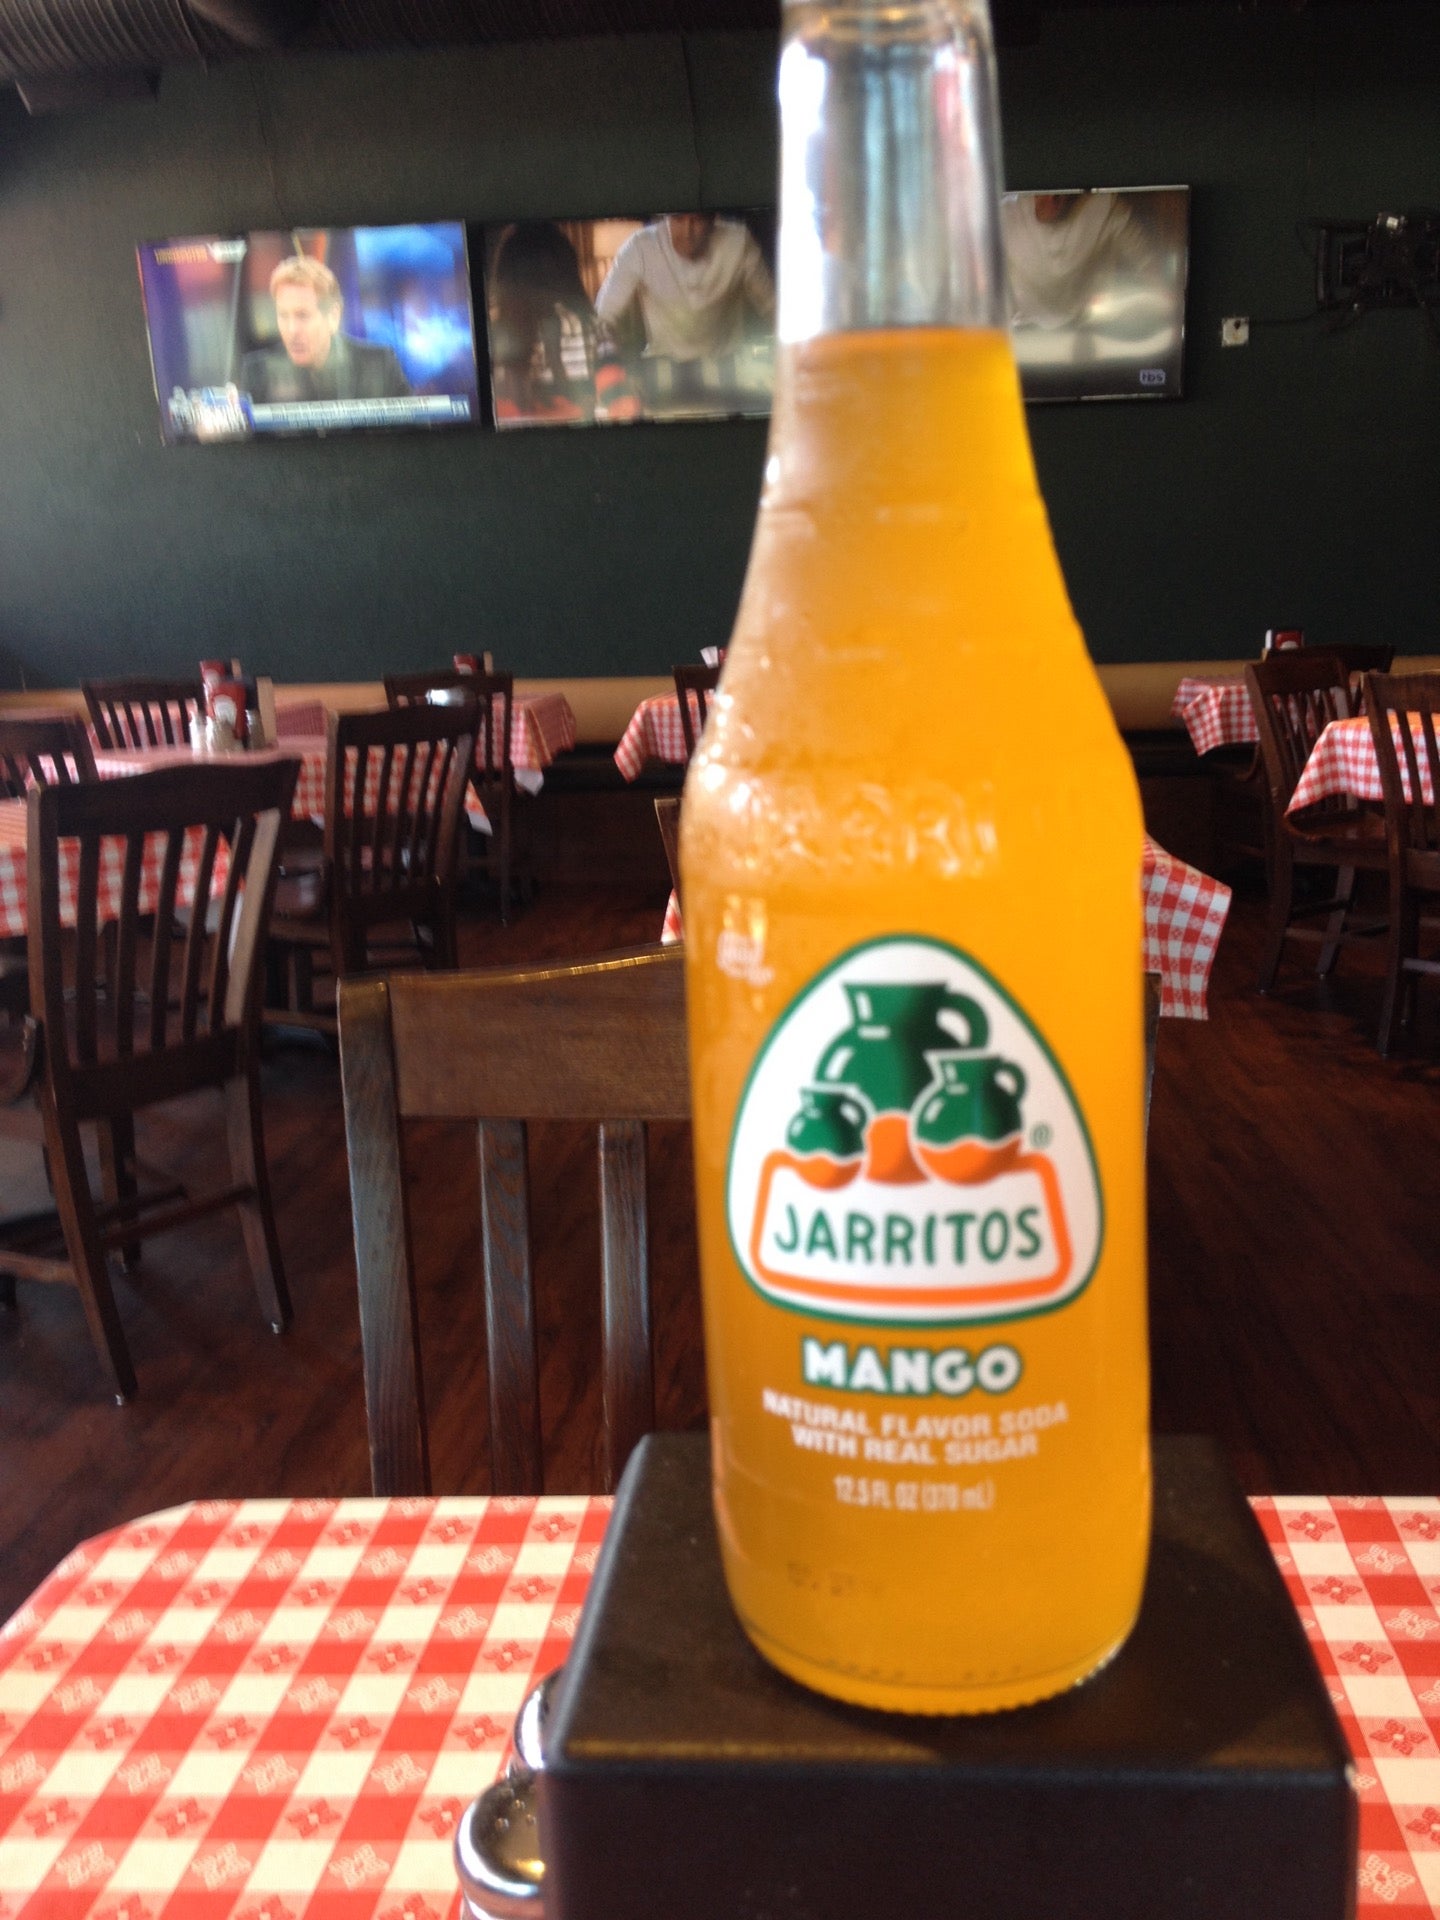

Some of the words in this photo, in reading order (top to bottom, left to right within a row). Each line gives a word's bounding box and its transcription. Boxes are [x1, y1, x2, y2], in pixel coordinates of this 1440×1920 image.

[774, 1203, 1041, 1265] JARRITOS
[802, 1335, 1021, 1397] MANGO
[762, 1387, 873, 1436] NATURAL
[880, 1412, 992, 1440] FLAVOR
[999, 1400, 1069, 1436] SODA
[791, 1423, 858, 1459] WITH
[863, 1435, 936, 1465] REAL
[944, 1432, 1038, 1465] SUGAR
